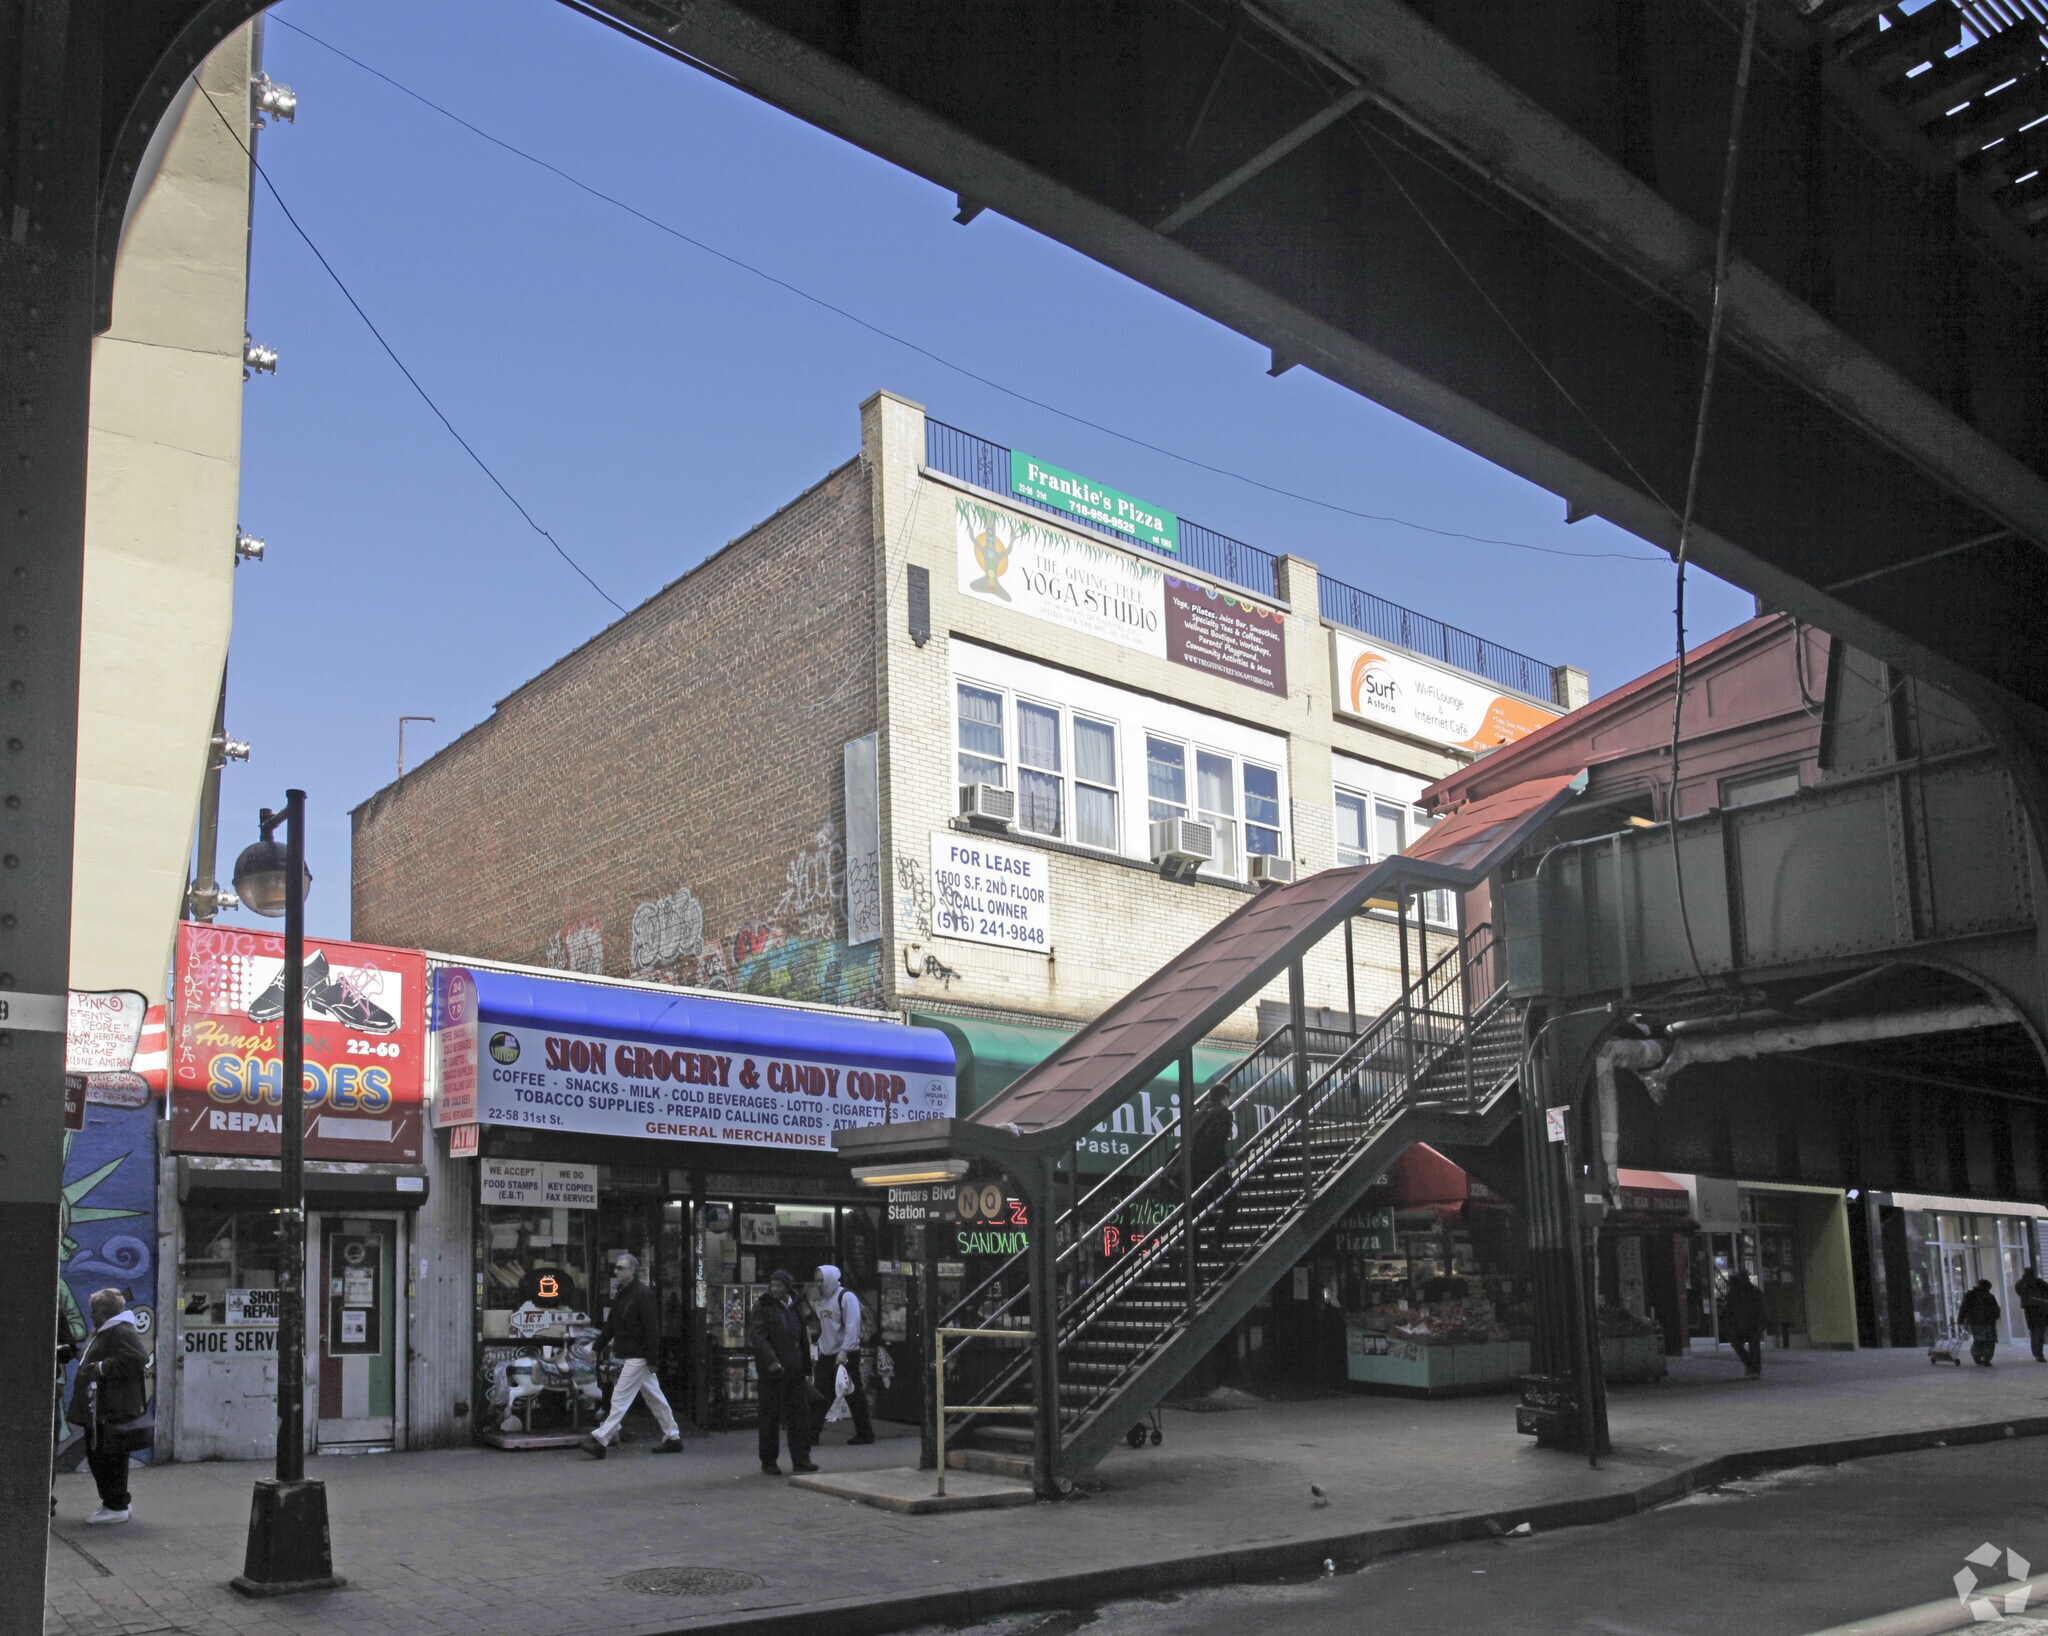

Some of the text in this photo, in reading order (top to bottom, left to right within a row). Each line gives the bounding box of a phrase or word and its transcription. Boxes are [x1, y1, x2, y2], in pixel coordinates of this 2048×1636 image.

[1028, 463, 1164, 532] Frankie's Pizza
[1069, 500, 1136, 534] 718-956-9525
[1034, 554, 1144, 605] THE GIVING TREE
[1022, 567, 1079, 607] YOGA
[1084, 589, 1157, 632] STUDIO
[1173, 597, 1190, 610] Yoga,
[1219, 613, 1233, 625] Juice
[1184, 621, 1209, 635] Wellness
[1192, 614, 1219, 630] Specialty
[1220, 623, 1233, 634] Teas
[1235, 628, 1240, 637] &
[1186, 641, 1221, 660] Community
[1222, 653, 1248, 668] Activities
[1257, 665, 1272, 675] More
[1365, 675, 1396, 700] Surf
[1415, 681, 1464, 710] Wi-Fi Lounge
[1367, 696, 1396, 713] Astoria
[1439, 706, 1444, 714] &
[1415, 708, 1469, 737] Internet Café
[951, 846, 1031, 877] FOR LEASE
[964, 875, 982, 891] S.F.
[986, 879, 1007, 896] 2ND
[1011, 884, 1045, 903] FLOOR
[954, 893, 1028, 920] CALL OWNER
[937, 911, 1044, 945] (516) 241-9848
[452, 982, 462, 993] 24
[70, 1009, 112, 1023] ESENTS
[94, 1032, 134, 1043] HERITAGE
[194, 1021, 275, 1057] Hong's
[346, 1040, 400, 1057] 22-60
[545, 1036, 607, 1075] SION
[615, 1045, 732, 1087] GROCERY
[739, 1058, 760, 1090] &
[767, 1061, 840, 1098] CANDY
[847, 1070, 909, 1105] CORP.
[493, 1069, 545, 1087] COFFEE
[566, 1077, 618, 1095] SNACKS
[629, 1085, 661, 1099] MILK
[672, 1089, 704, 1104] COLD
[709, 1093, 777, 1110] BEVERAGES
[787, 1099, 822, 1114] LOTTO
[907, 1109, 945, 1121] CIGARS
[925, 1092, 947, 1100] HOURS
[489, 1108, 564, 1125] 22-58 31st St.
[515, 1089, 584, 1107] TOBACCO
[589, 1096, 655, 1114] SUPPLIES
[667, 1104, 721, 1121] PREPAID
[726, 1109, 778, 1125] CALLING
[783, 1115, 822, 1129] CARDS
[833, 1119, 857, 1131] ATM
[453, 1125, 476, 1149] ATM
[646, 1122, 826, 1146] GENERAL MERCHANDISE
[1076, 1138, 1130, 1156] Pasta
[489, 1166, 536, 1177] WE ACCEPT
[559, 1170, 584, 1179] WE DO
[483, 1179, 539, 1191] FOOD STAMPS
[548, 1182, 594, 1192] KEY COPIES
[889, 1186, 956, 1203] Ditmars Blvd
[498, 1191, 525, 1201] (E.B.T)
[546, 1192, 595, 1203] FAX SERVICE
[888, 1205, 926, 1220] Station
[1336, 1231, 1380, 1250] Pizza
[185, 1332, 228, 1352] SHOE
